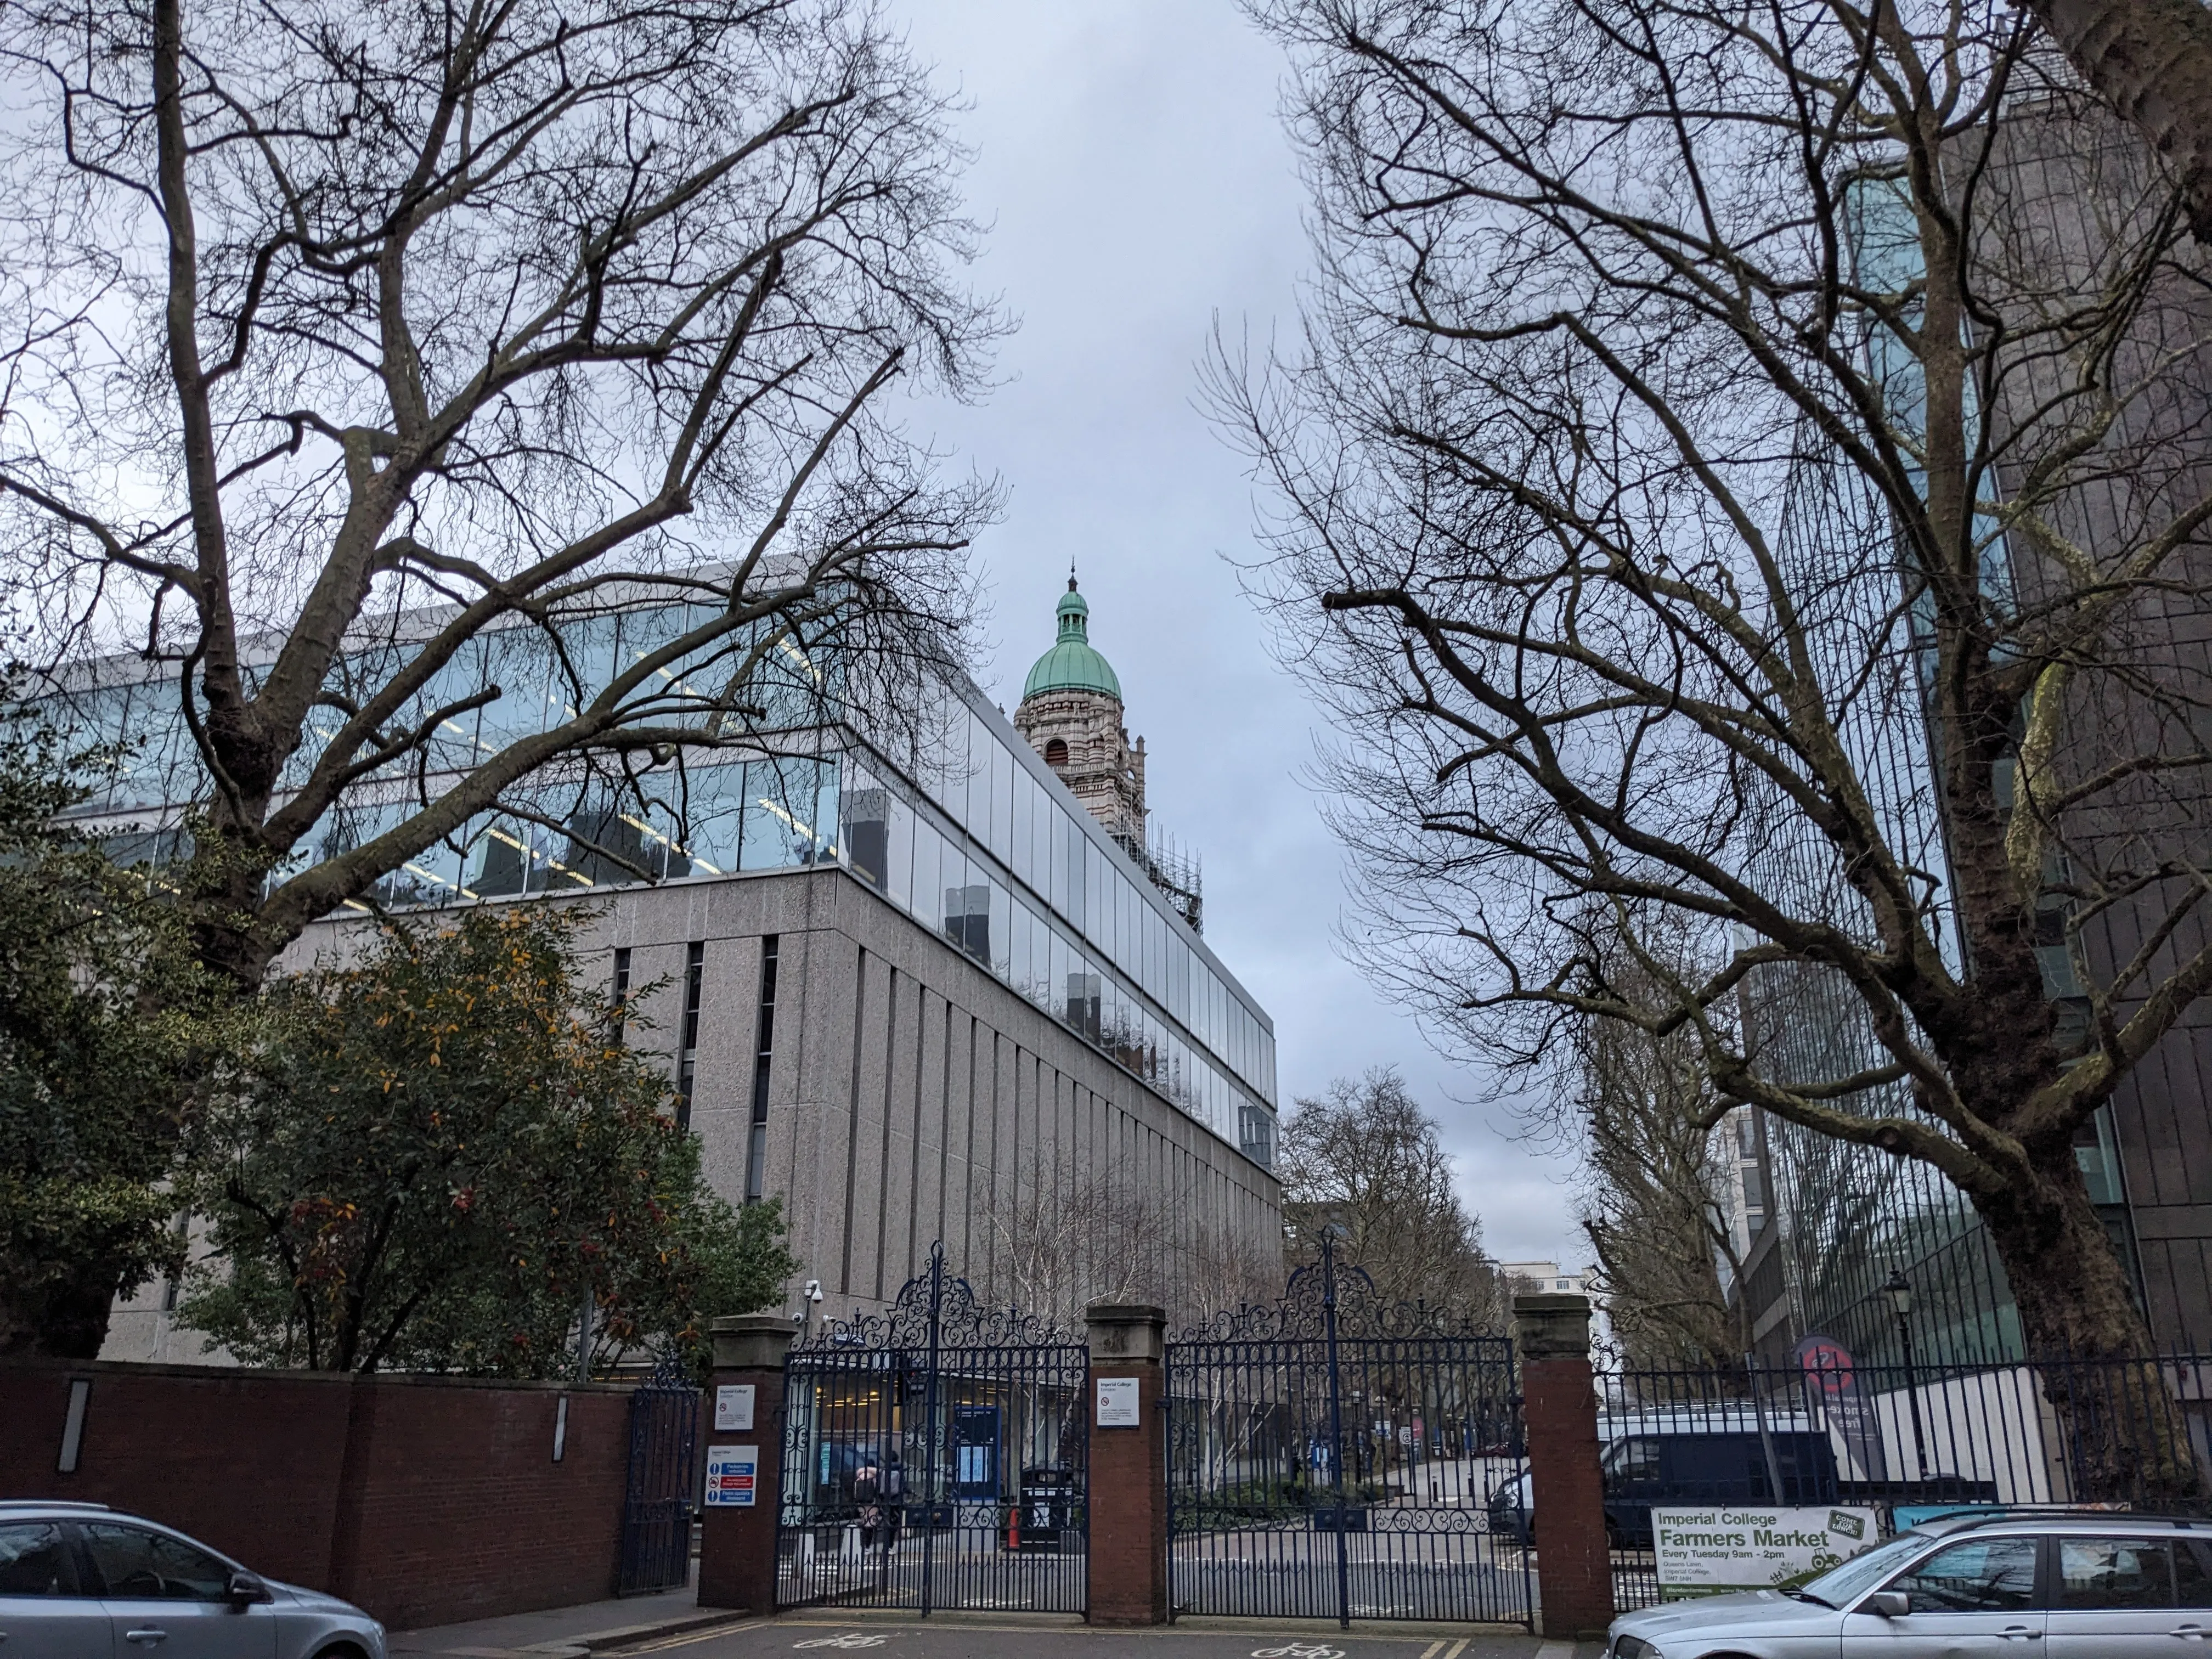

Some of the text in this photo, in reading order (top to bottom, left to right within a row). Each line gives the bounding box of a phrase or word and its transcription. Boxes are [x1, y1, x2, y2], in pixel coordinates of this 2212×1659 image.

[1658, 1513, 1777, 1527] Imperial College
[1836, 1515, 1858, 1526] COME
[1839, 1521, 1853, 1529] FOR
[1832, 1523, 1858, 1536] LUNCH!
[1660, 1529, 1829, 1547] Farmers Market
[1662, 1549, 1688, 1559] Every
[1691, 1549, 1729, 1560] Tuesday
[1732, 1550, 1753, 1559] 9am
[1763, 1550, 1785, 1560] 2pm
